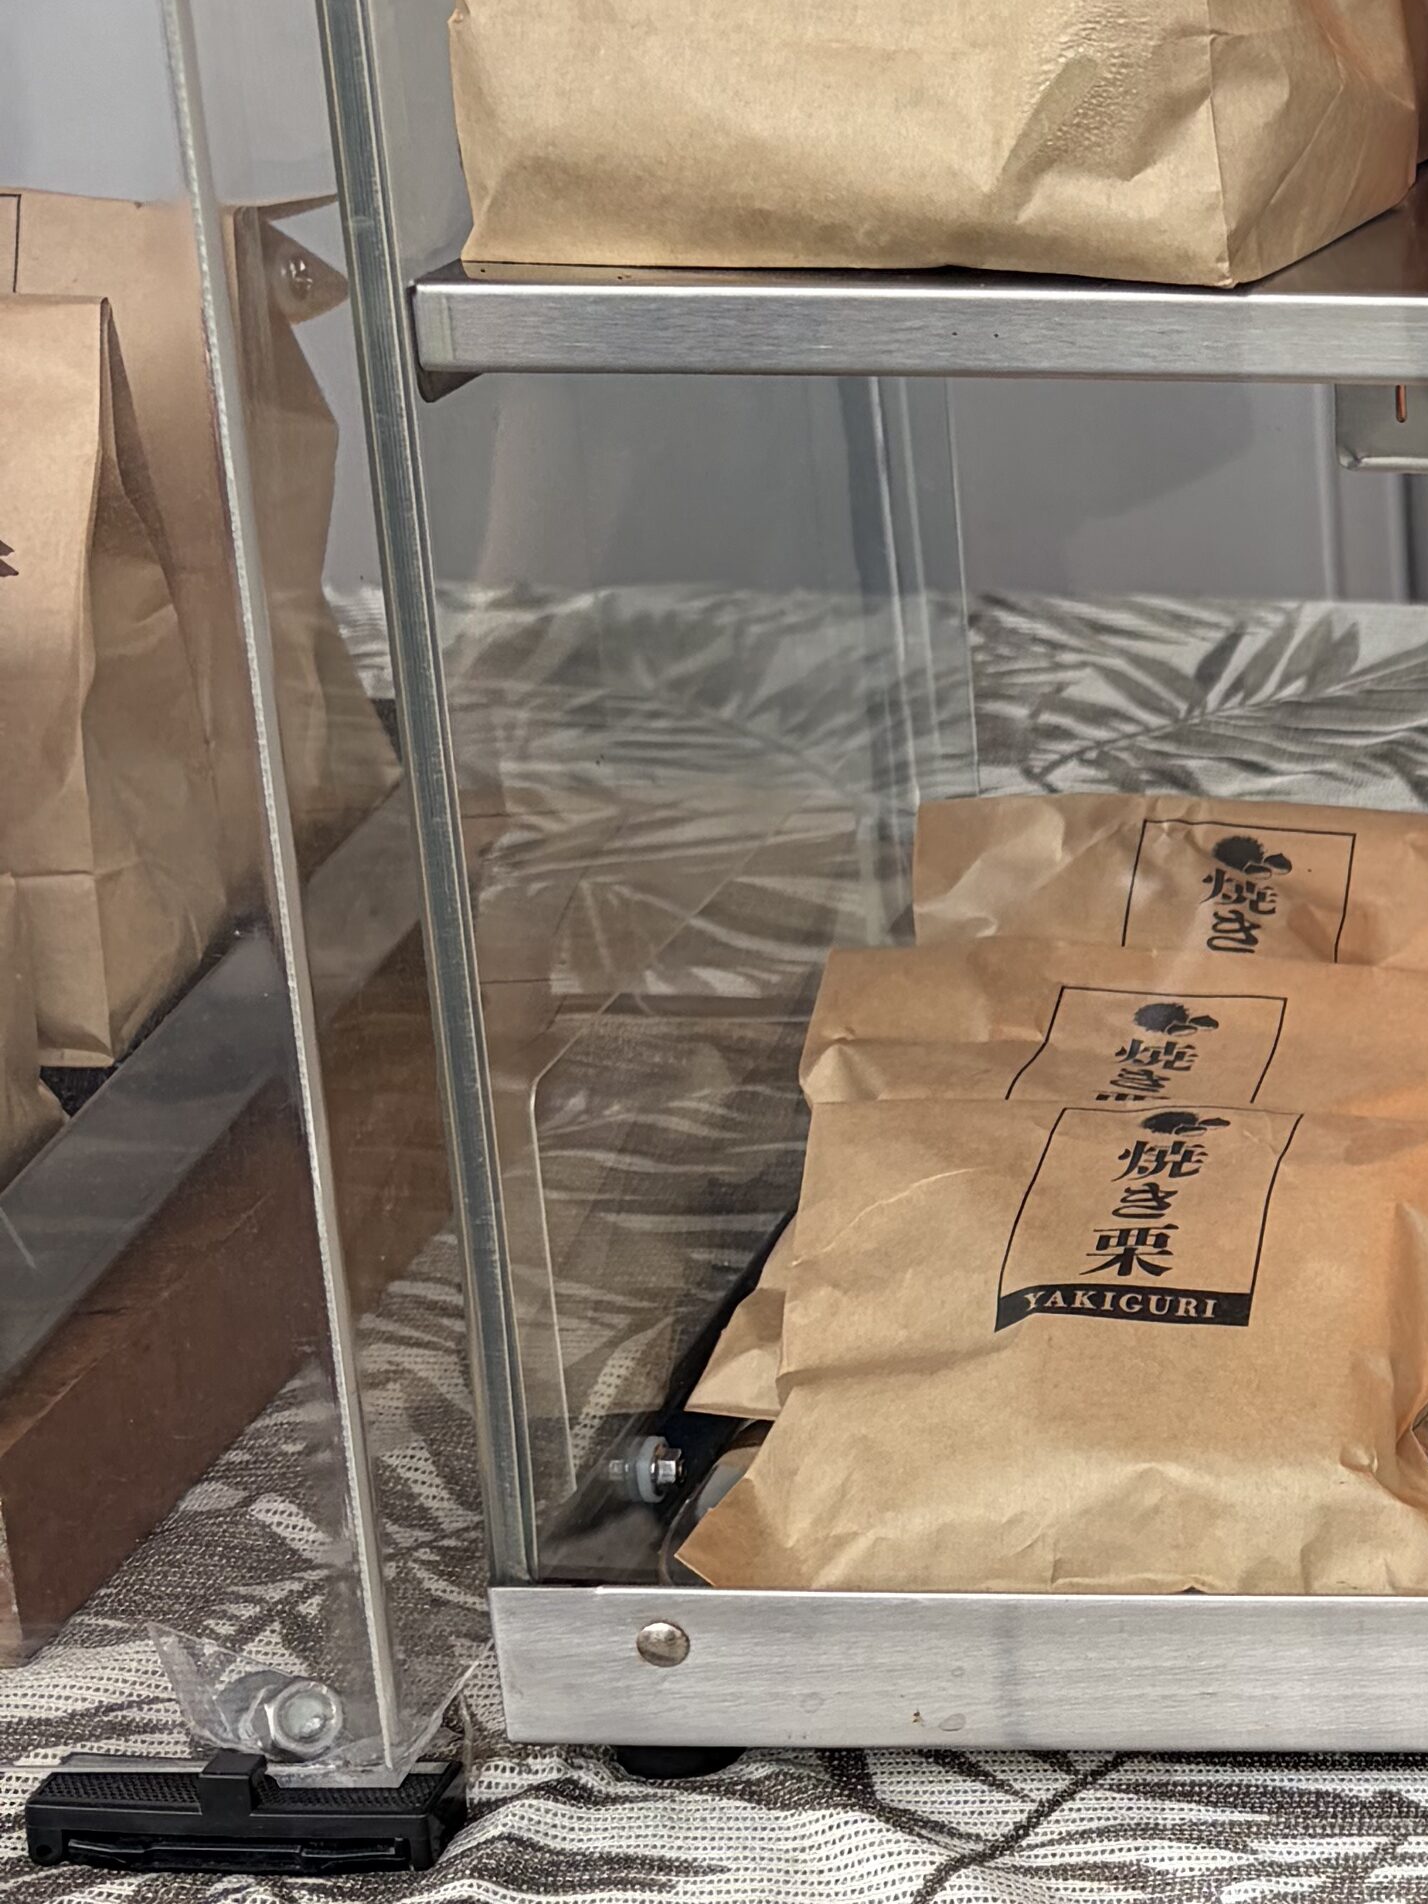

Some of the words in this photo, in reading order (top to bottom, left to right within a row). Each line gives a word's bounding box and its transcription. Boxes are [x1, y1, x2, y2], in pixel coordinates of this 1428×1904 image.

[1200, 868, 1279, 954] 焼き
[1095, 1038, 1199, 1101] 焼き
[1079, 1140, 1208, 1277] 焼き栗
[1022, 1288, 1219, 1320] YAKIGURI
